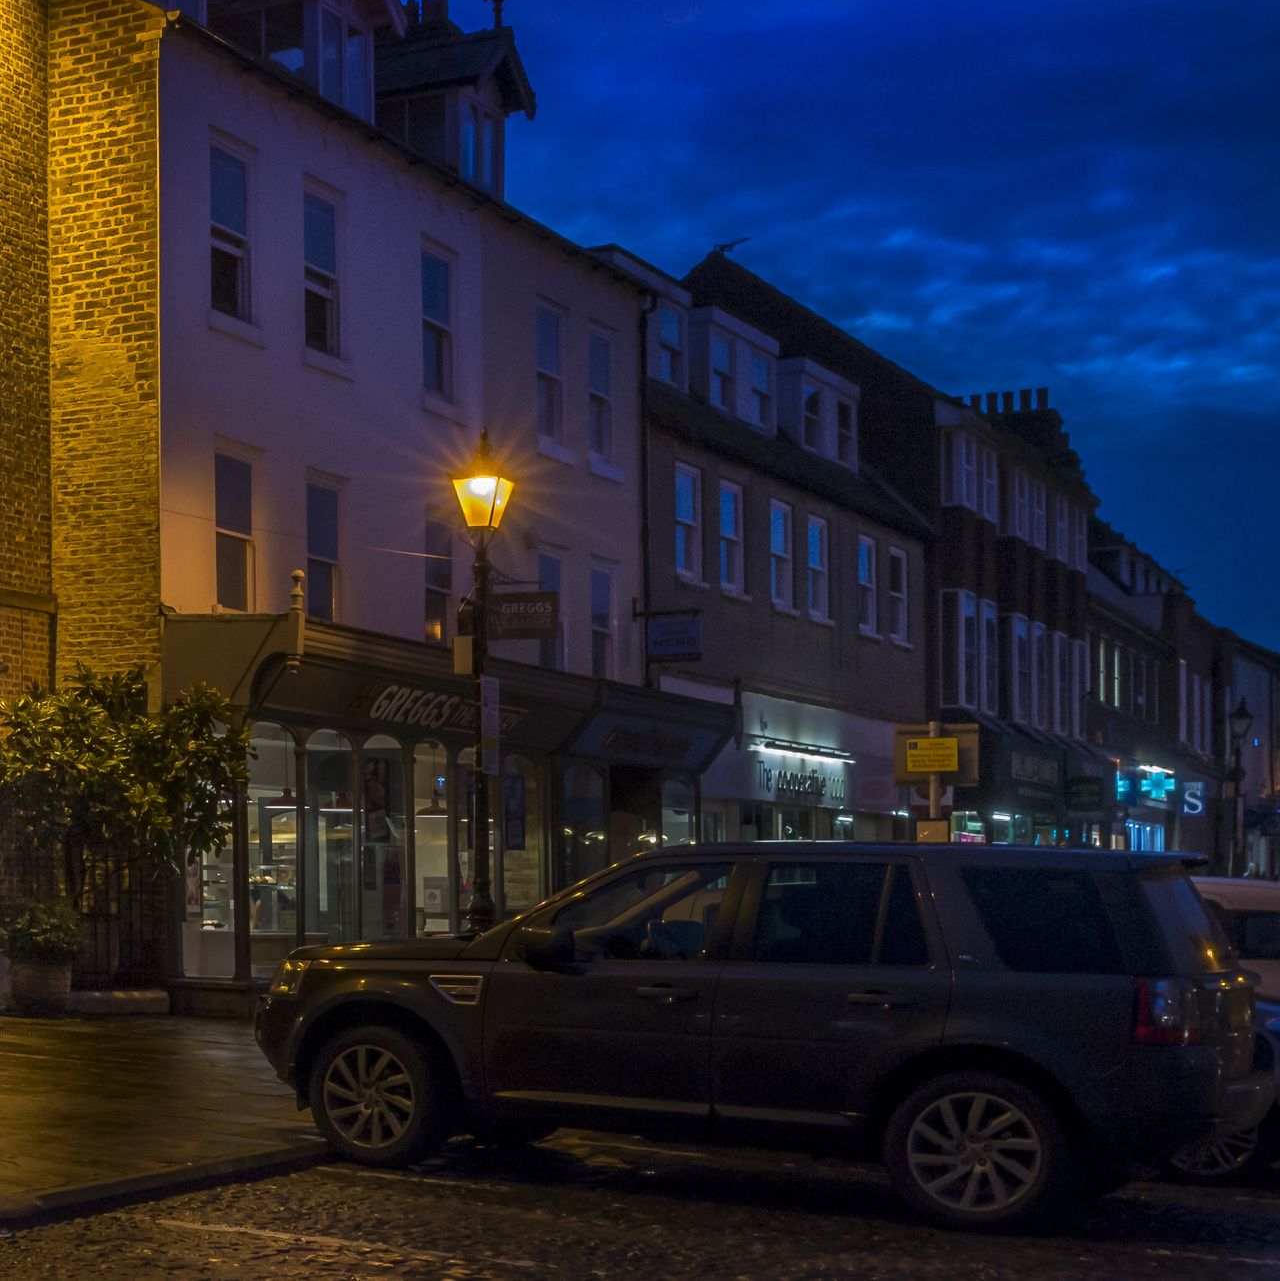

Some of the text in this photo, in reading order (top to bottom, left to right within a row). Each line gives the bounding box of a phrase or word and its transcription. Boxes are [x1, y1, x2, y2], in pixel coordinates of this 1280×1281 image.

[502, 602, 553, 614] GREGGS
[652, 637, 697, 647] NERO
[369, 684, 463, 729] GREGGS
[757, 760, 773, 793] The
[777, 768, 827, 796] co-operative
